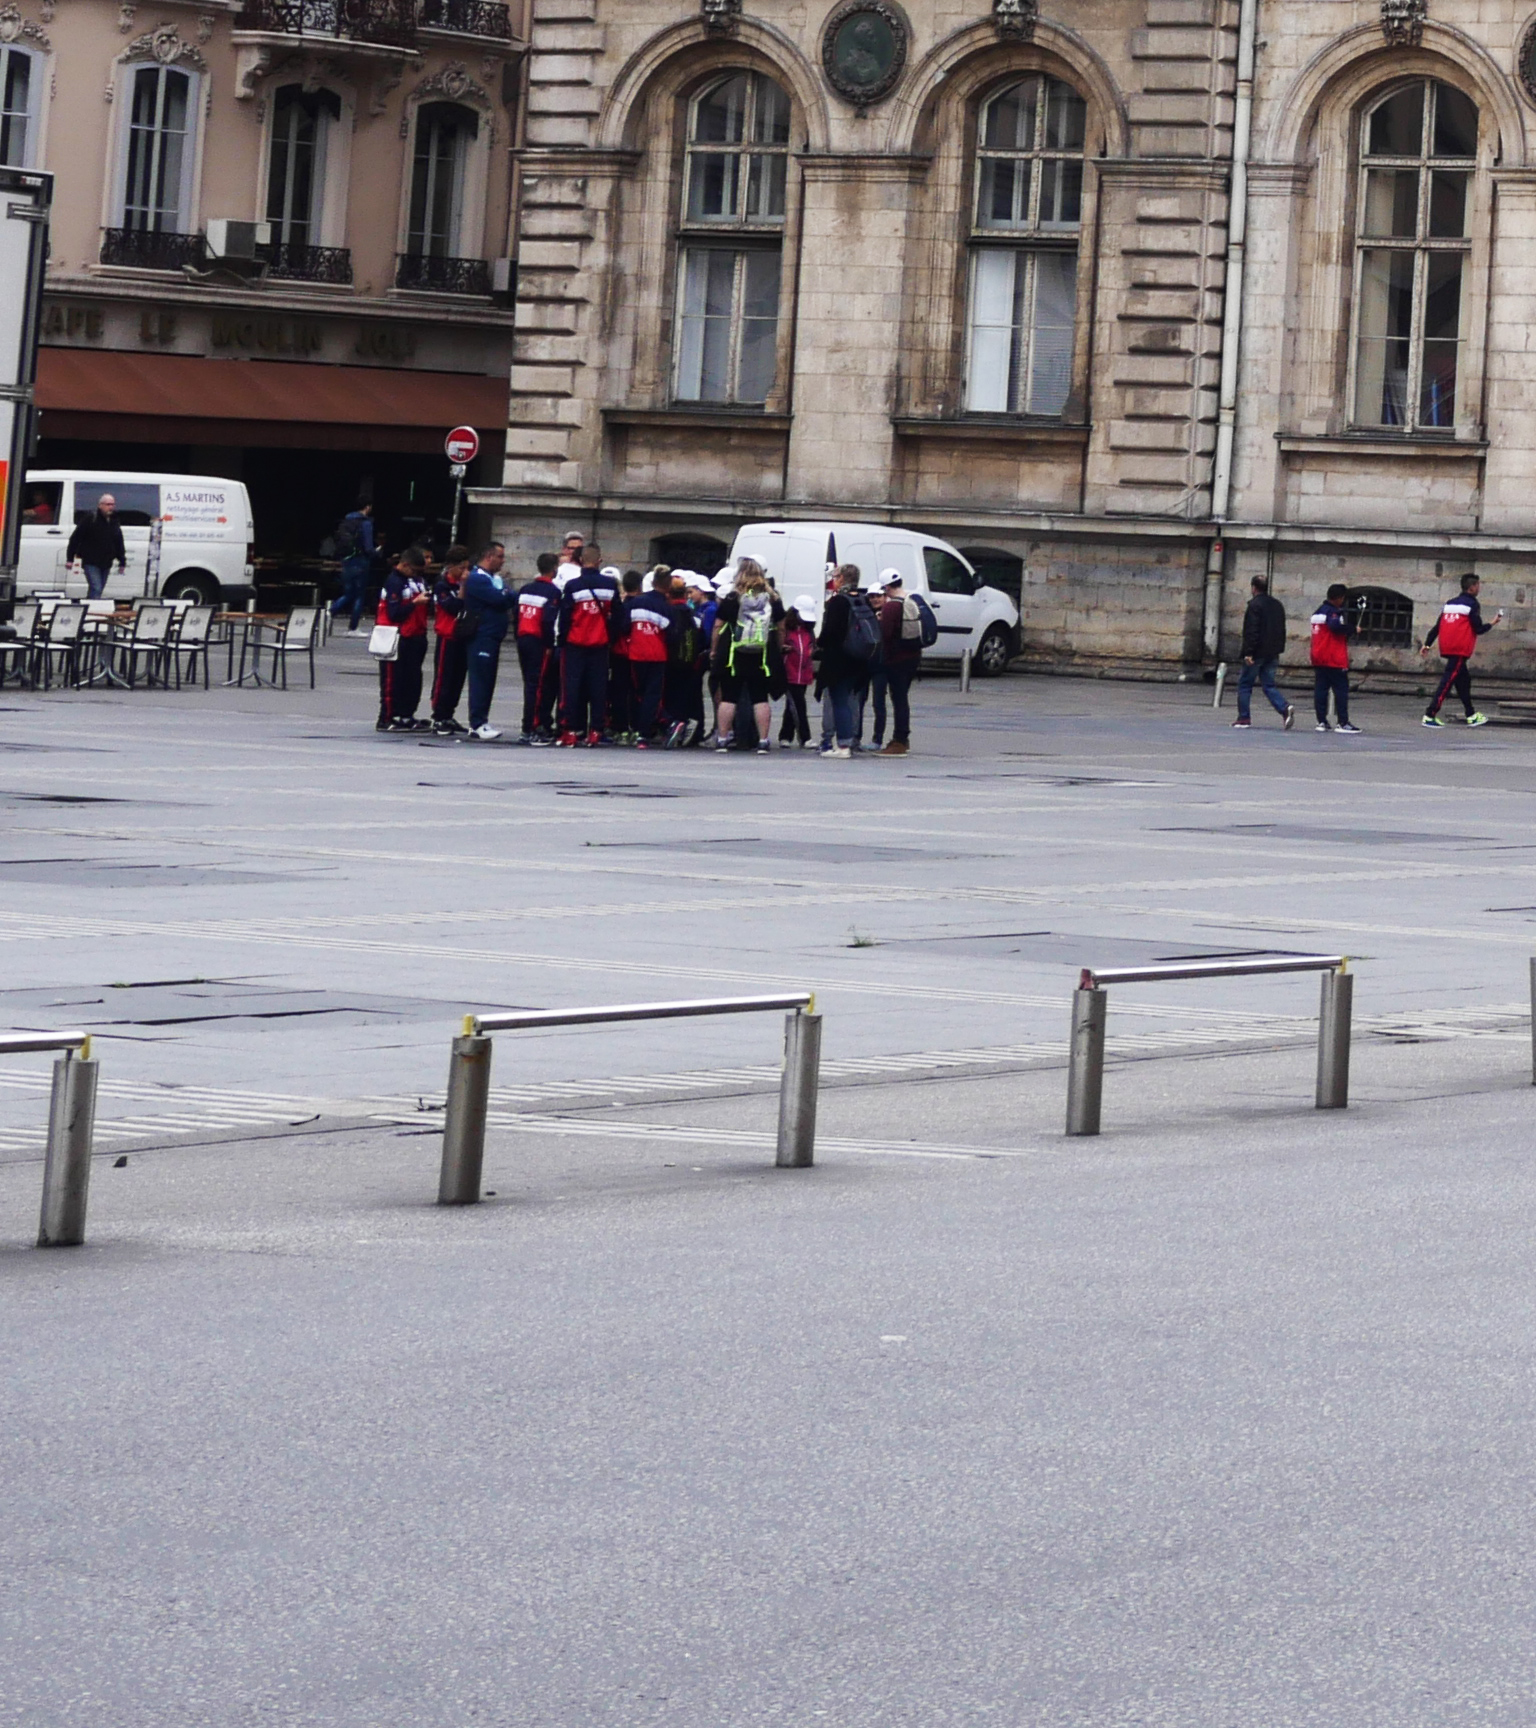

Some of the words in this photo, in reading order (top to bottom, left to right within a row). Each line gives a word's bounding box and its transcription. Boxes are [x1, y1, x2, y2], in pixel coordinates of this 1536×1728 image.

[41, 305, 105, 341] AFE
[139, 311, 177, 345] LE
[210, 315, 323, 355] MOULIN
[183, 493, 225, 504] MARTINS
